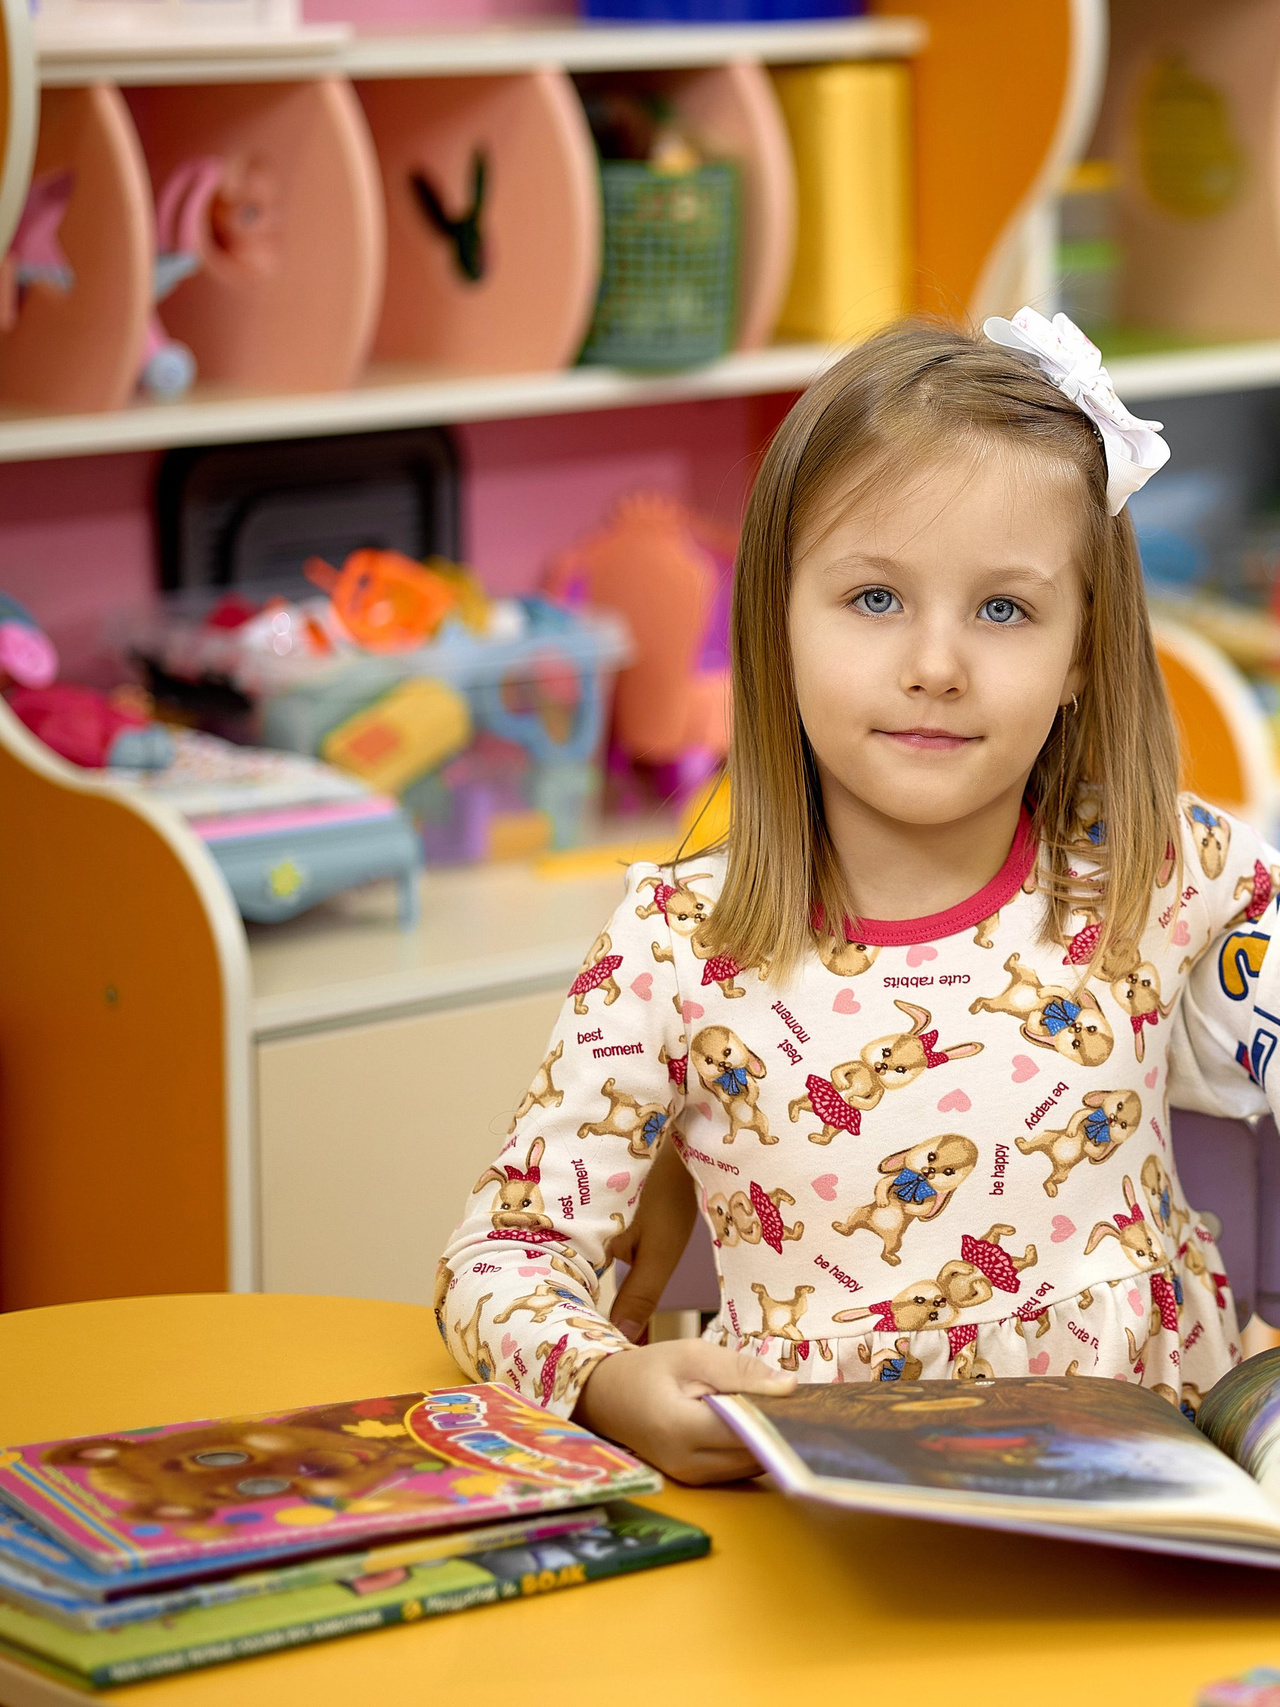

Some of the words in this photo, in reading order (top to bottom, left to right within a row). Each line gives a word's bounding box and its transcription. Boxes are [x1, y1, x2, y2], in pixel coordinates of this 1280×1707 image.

[1181, 885, 1199, 900] be
[1158, 900, 1187, 928] hppy
[884, 977, 933, 988] rabbits
[939, 975, 970, 985] cute
[771, 1001, 811, 1044] moment
[578, 1029, 603, 1044] best
[592, 1041, 644, 1059] moment
[777, 1038, 803, 1066] best
[1050, 1081, 1070, 1099] be
[1024, 1093, 1061, 1131] happy
[717, 1160, 740, 1176] cute
[989, 1143, 1010, 1177] happy
[571, 1158, 591, 1206] moment
[988, 1180, 1004, 1196] be
[473, 1263, 501, 1275] cute
[814, 1255, 834, 1272] be
[829, 1264, 864, 1293] happy
[1036, 1282, 1054, 1296] be
[1068, 1321, 1089, 1342] cute
[514, 1350, 527, 1376] best
